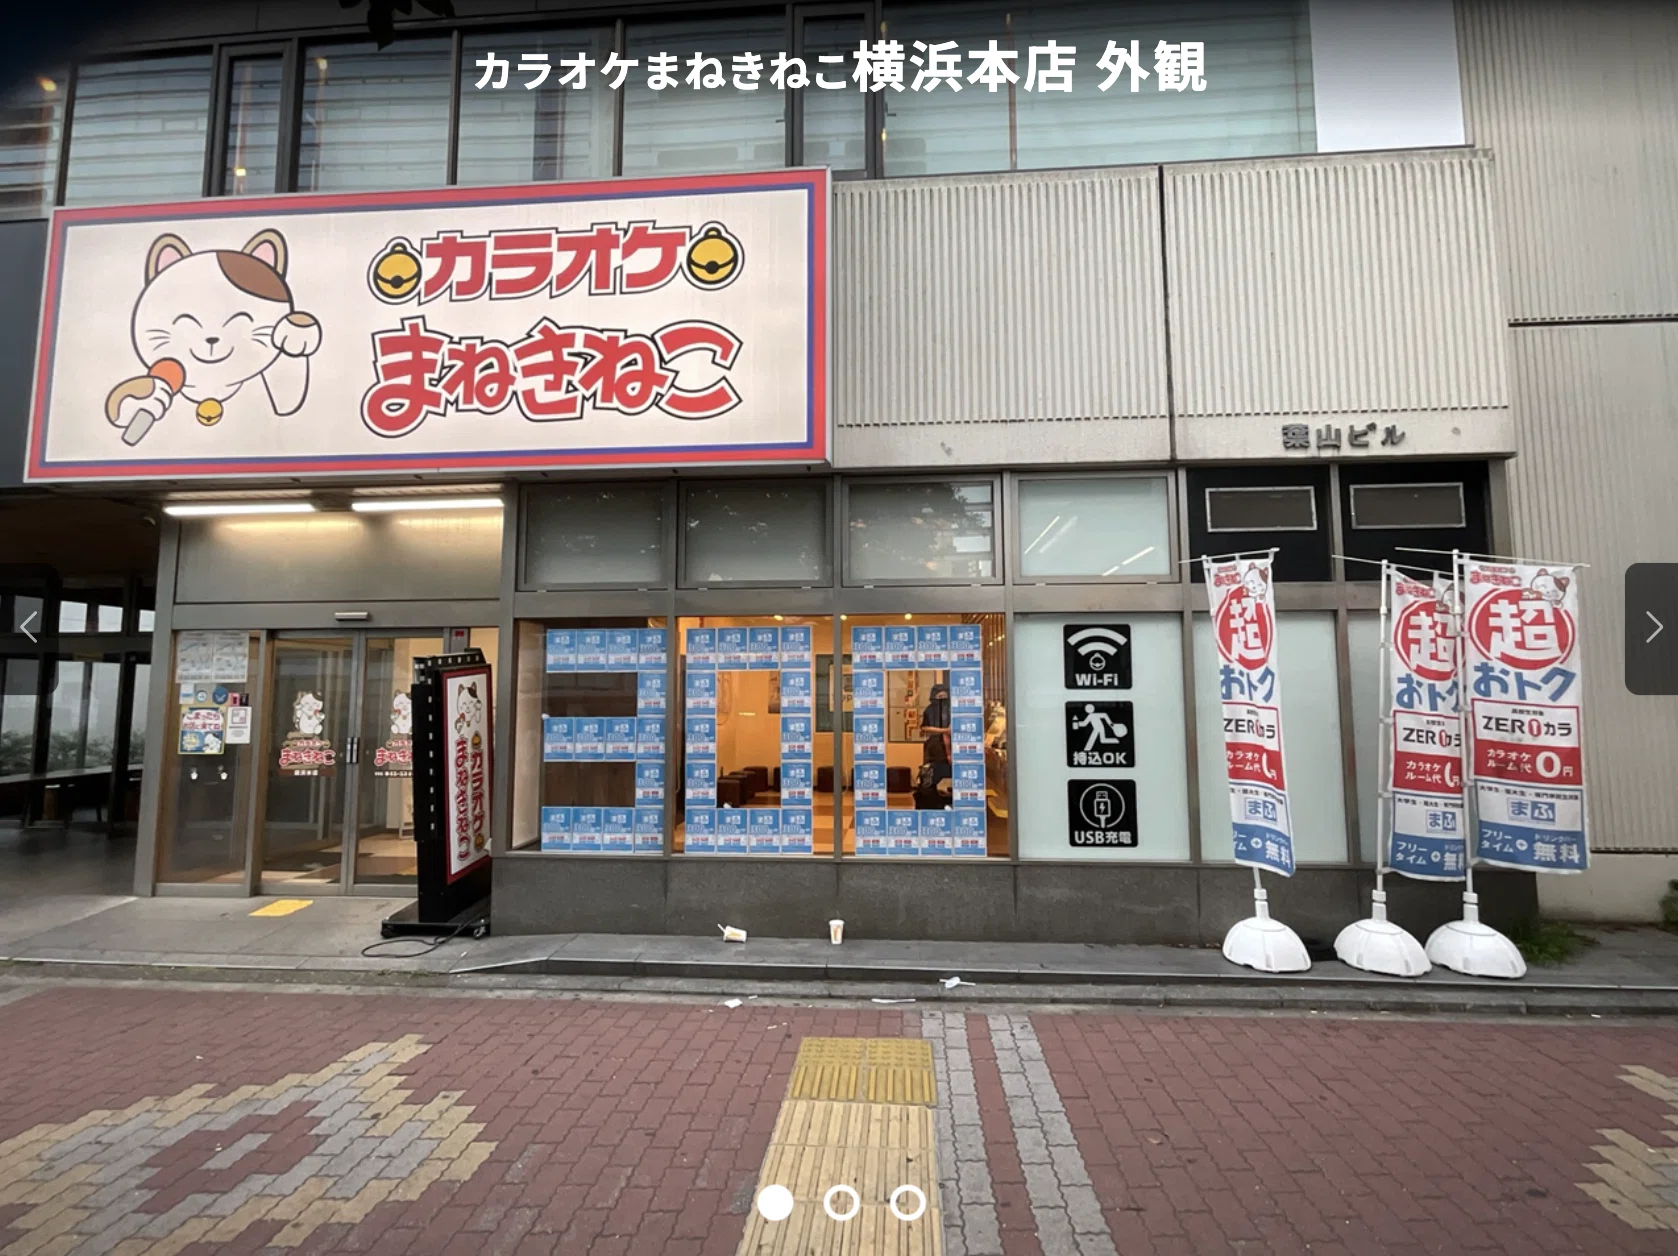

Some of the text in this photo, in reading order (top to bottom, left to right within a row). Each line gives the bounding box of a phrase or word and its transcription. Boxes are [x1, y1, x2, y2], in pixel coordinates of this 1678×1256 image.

[418, 221, 689, 304] カラオケ
[361, 317, 744, 438] まねきねこ
[1229, 596, 1266, 661] 超
[1488, 599, 1562, 661] 超
[1407, 611, 1457, 671] 超
[1075, 673, 1119, 687] Wi-Fi
[1219, 664, 1275, 703] おトク
[1472, 661, 1577, 703] おトク
[1073, 751, 1127, 766] 持込OK
[1486, 748, 1533, 761] カラオケ
[1406, 760, 1442, 773] カラオケ
[454, 735, 471, 861] まねきねこ
[470, 750, 485, 834] カラオケ
[1428, 811, 1457, 831] まふ
[1509, 801, 1556, 822] まふ
[1074, 831, 1132, 845] USB充電
[1481, 828, 1513, 840] フリー
[1265, 840, 1291, 868] 無料
[1397, 841, 1428, 853] フリー
[1480, 840, 1514, 853] タイム
[1533, 842, 1581, 864] 無料
[1395, 853, 1427, 865] タイム
